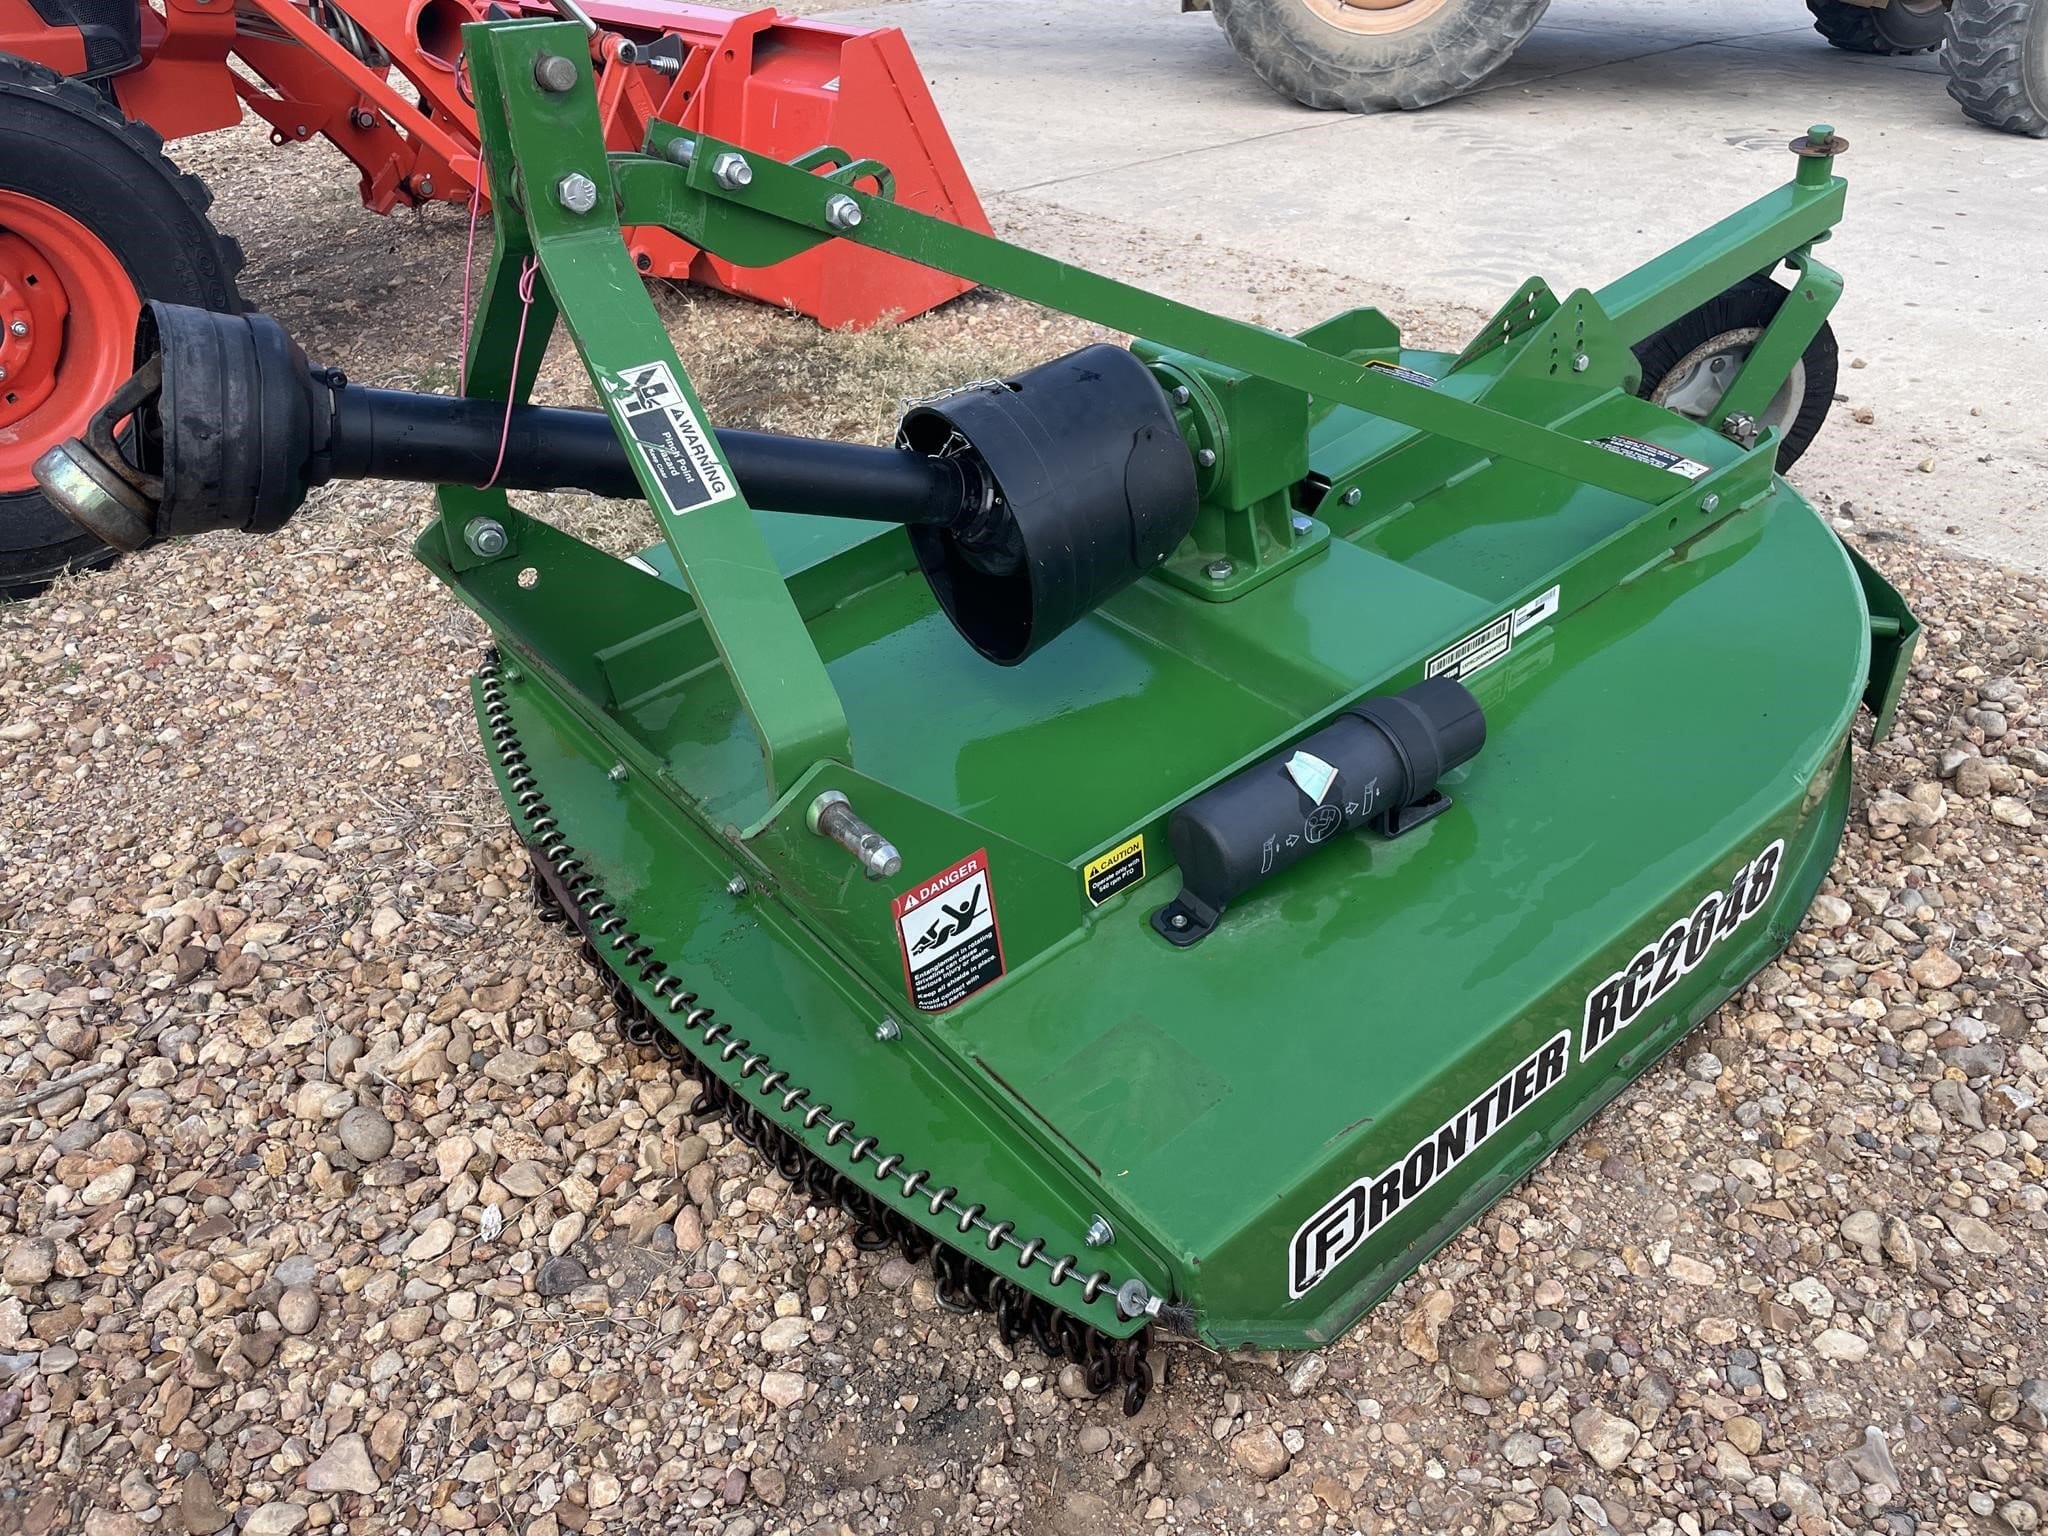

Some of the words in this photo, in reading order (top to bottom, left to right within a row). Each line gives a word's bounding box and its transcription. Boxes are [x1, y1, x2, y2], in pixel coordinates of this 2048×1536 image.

[648, 448, 659, 464] Keep
[656, 463, 668, 479] Clear
[662, 431, 680, 458] Pinch
[677, 459, 695, 483] Point
[679, 419, 725, 493] WARNING
[1101, 842, 1139, 870] CAUTION
[919, 860, 977, 900] DANGER
[1092, 873, 1115, 889] Operate
[1115, 866, 1127, 876] only
[1128, 858, 1140, 868] with
[1110, 876, 1121, 886] rpm
[1122, 868, 1134, 879] PTO
[914, 951, 960, 980] Entanglement
[960, 947, 967, 955] in
[967, 932, 993, 950] rotating
[915, 967, 945, 986] driveline
[945, 960, 958, 970] can
[958, 948, 978, 962] cause
[916, 977, 942, 992] serious
[943, 964, 962, 979] injury
[962, 959, 970, 967] or
[917, 990, 936, 999] Keep
[938, 984, 946, 993] all
[947, 970, 970, 988] shields
[918, 997, 940, 1006] Avoid
[941, 983, 965, 1000] contact
[966, 974, 980, 986] with
[918, 1001, 948, 1010] rotating
[1293, 1034, 1569, 1295] FRONTIER
[1583, 844, 1780, 1058] RC2048
